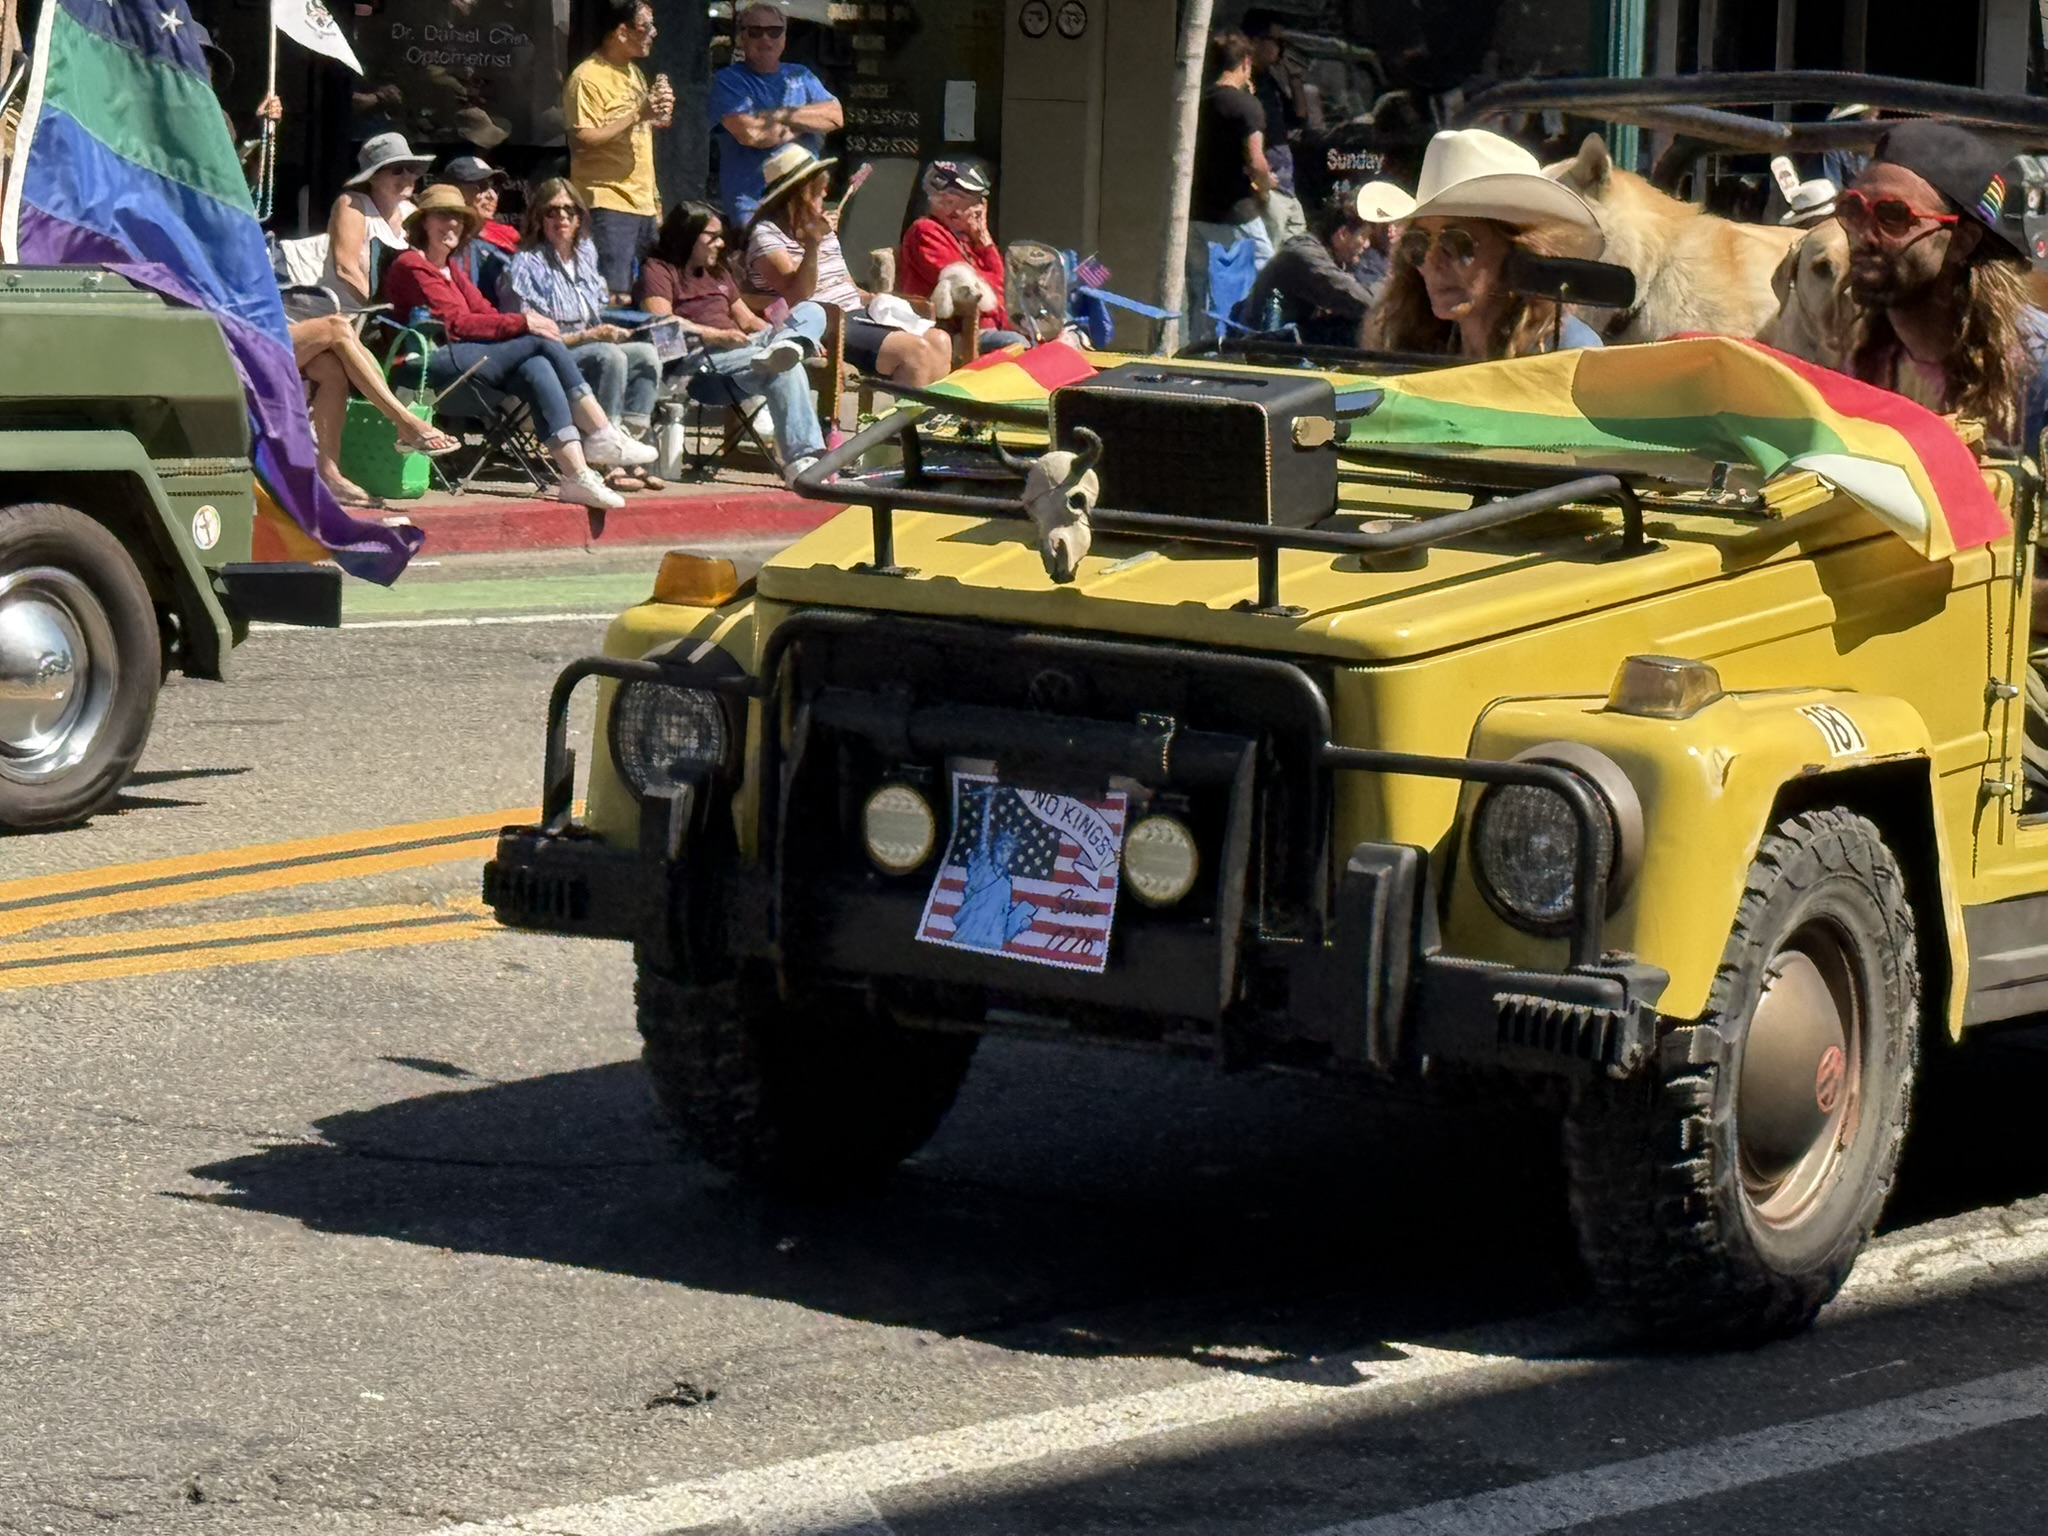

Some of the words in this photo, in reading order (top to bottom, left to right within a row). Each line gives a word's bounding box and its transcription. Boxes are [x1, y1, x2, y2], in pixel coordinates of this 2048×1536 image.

[391, 22, 415, 40] Dr.
[424, 24, 480, 43] Daniel
[405, 45, 513, 67] Optometrist
[1326, 147, 1385, 175] Sunday
[1801, 705, 1865, 753] 181
[1031, 791, 1060, 817] NO
[1060, 802, 1112, 857] KINGS
[1044, 927, 1097, 955] 1776
